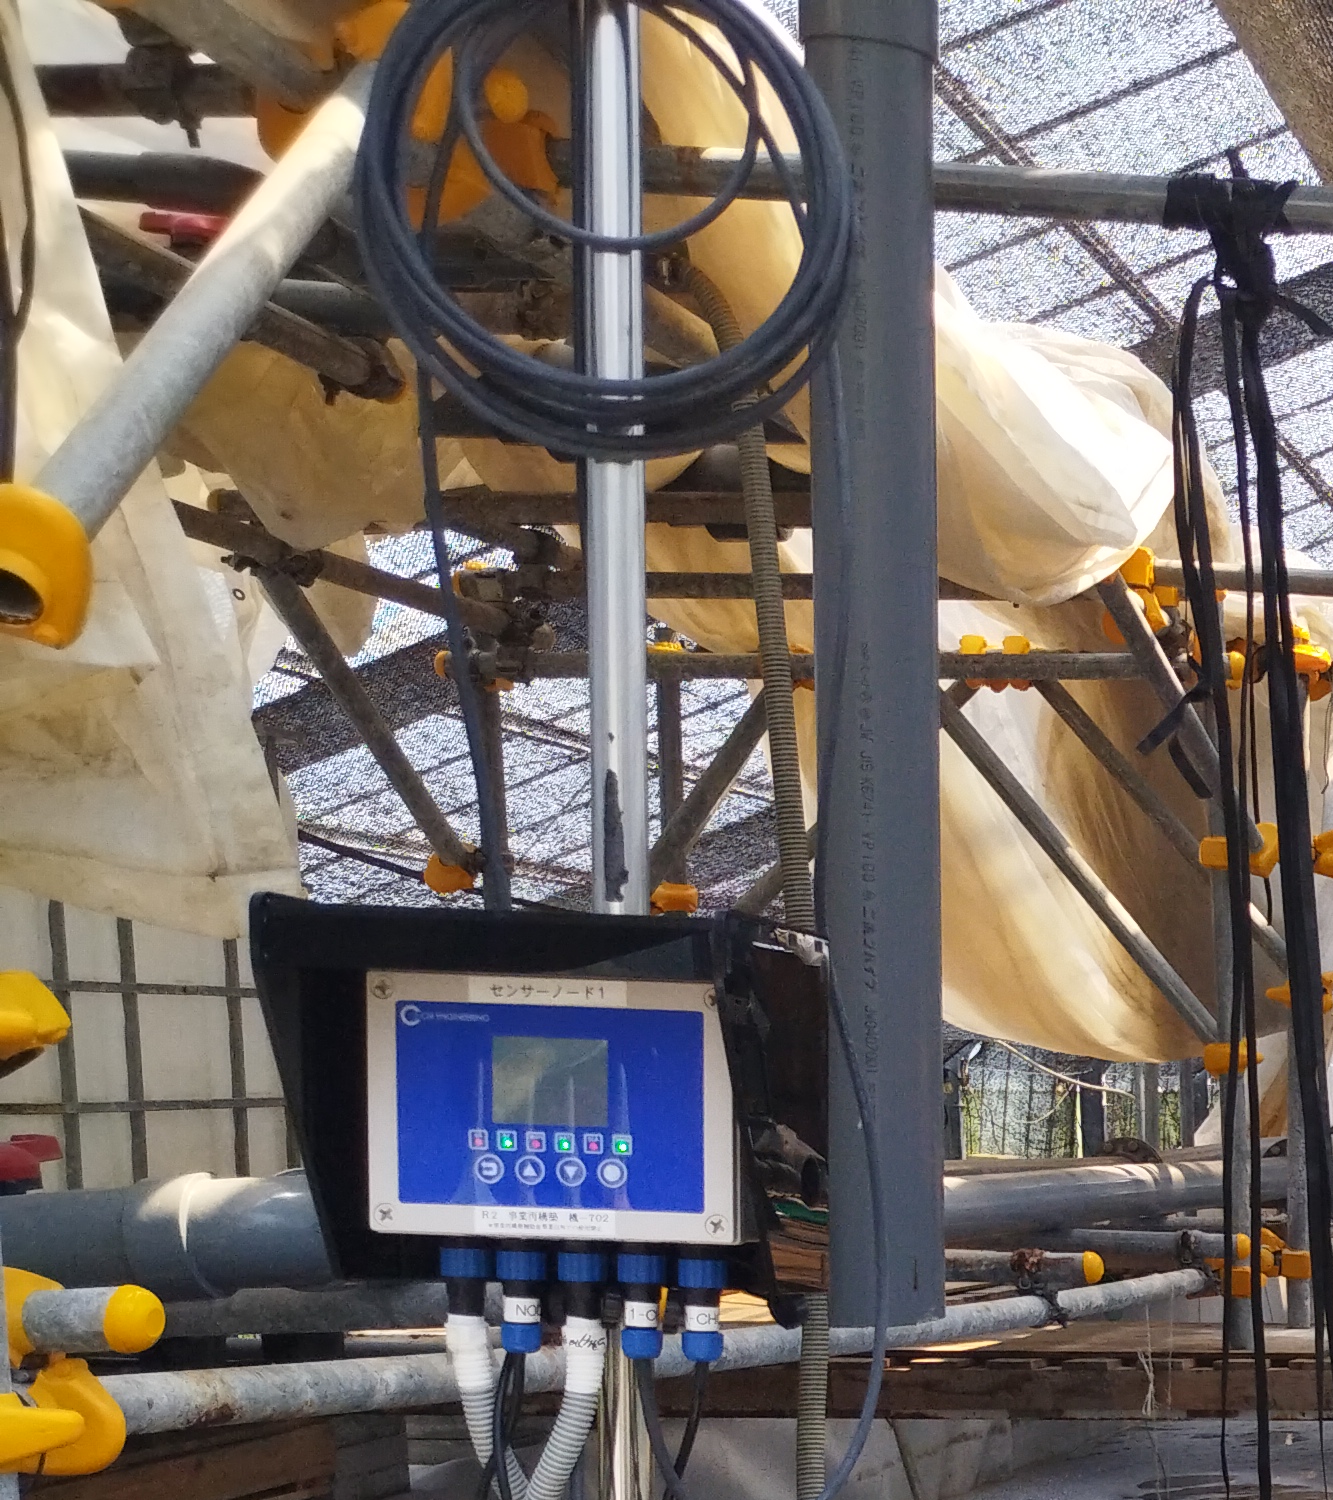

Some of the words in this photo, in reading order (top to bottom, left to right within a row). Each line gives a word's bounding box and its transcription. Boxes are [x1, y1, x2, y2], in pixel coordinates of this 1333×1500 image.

[489, 983, 606, 1000] センサーノード1
